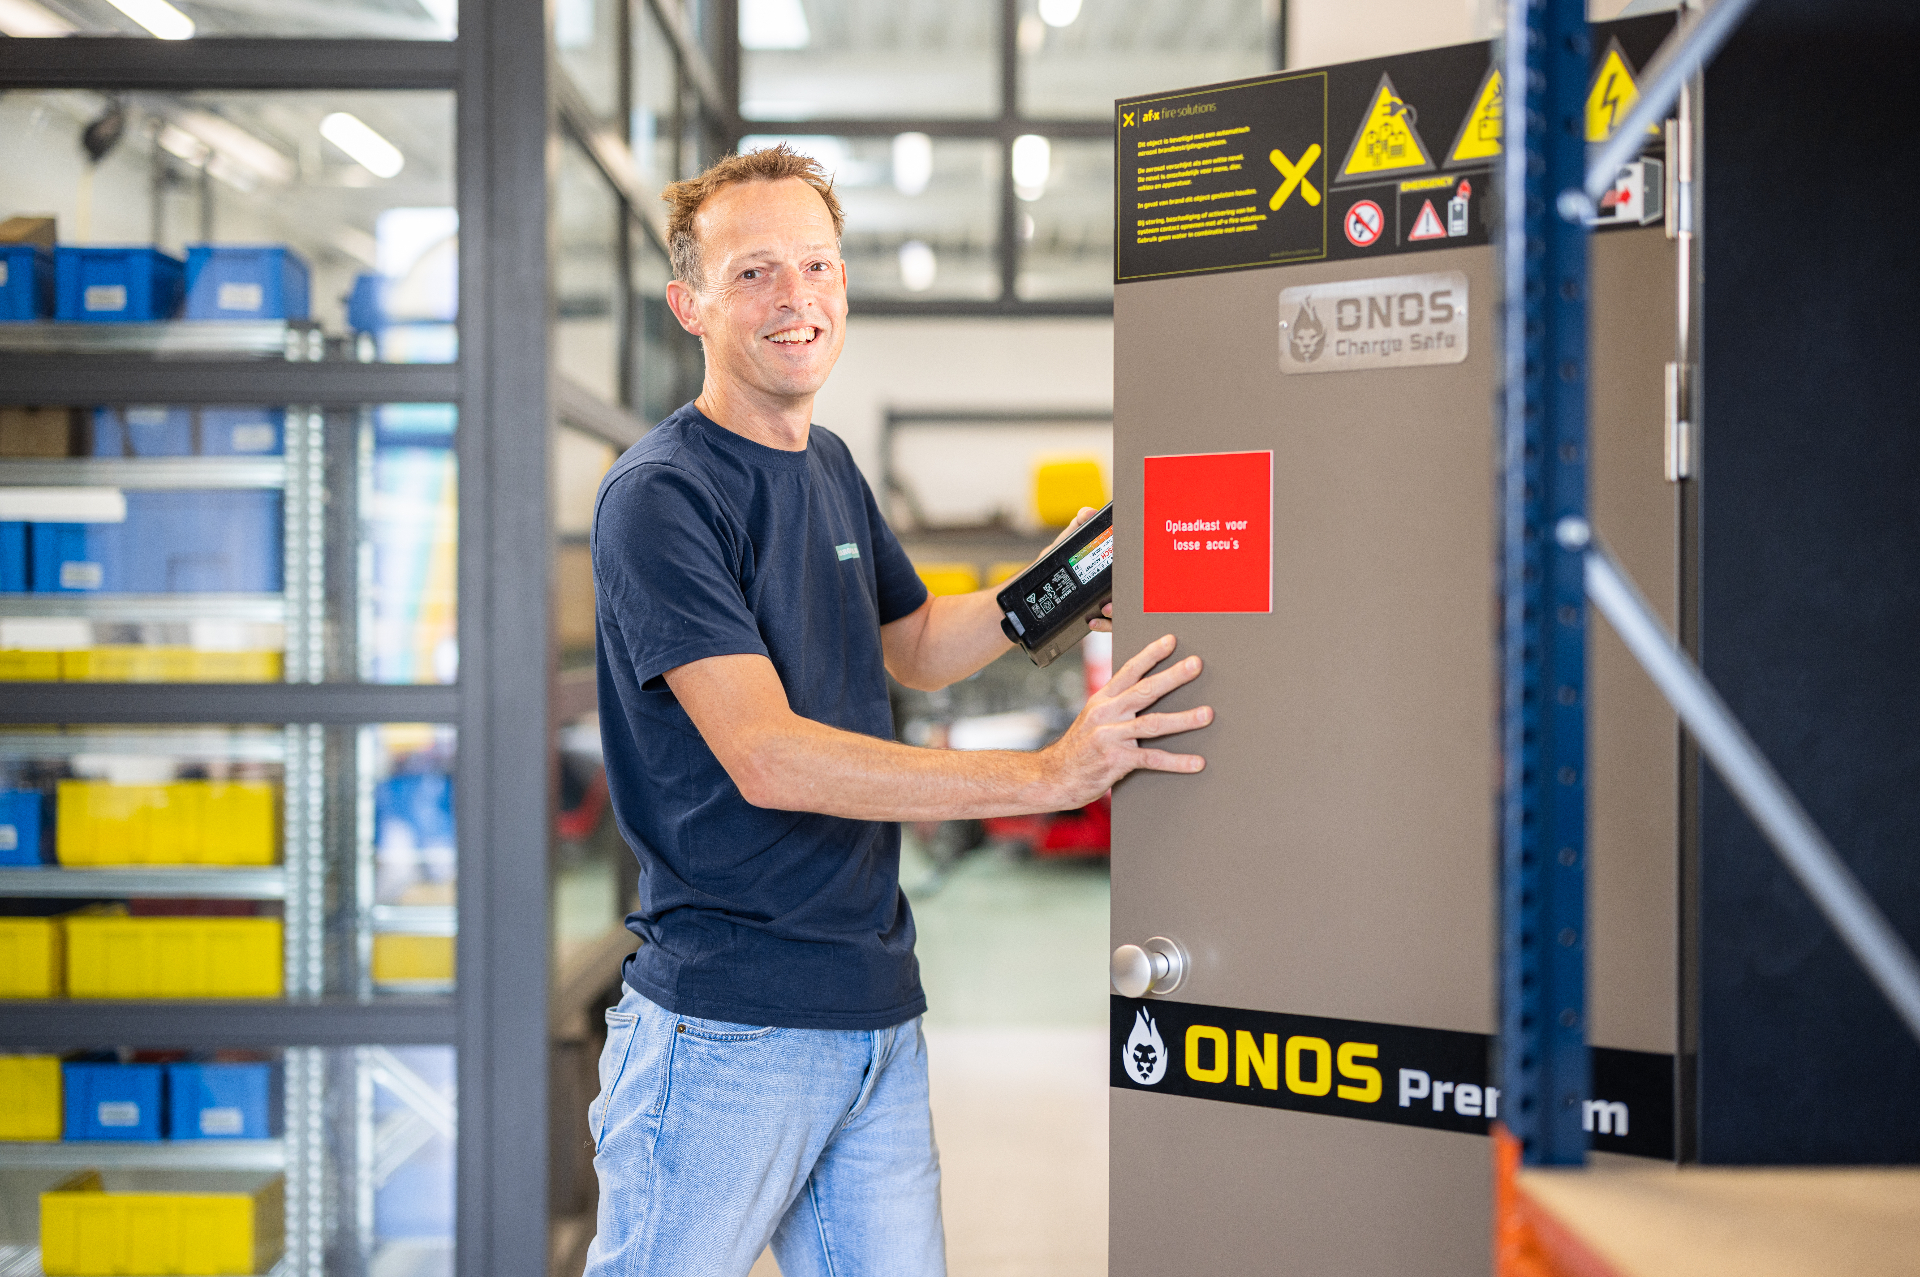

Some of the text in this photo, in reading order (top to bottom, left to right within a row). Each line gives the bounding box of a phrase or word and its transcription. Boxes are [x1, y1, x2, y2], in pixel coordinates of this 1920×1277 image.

[1161, 107, 1176, 119] fire
[1177, 104, 1216, 117] solutions
[1401, 176, 1454, 192] EMERGENCY
[1336, 290, 1453, 332] ONOS
[1336, 330, 1456, 357] Charge Safe
[1166, 519, 1248, 534] Oplaadkast voor
[1173, 537, 1239, 551] losse accu's
[1184, 1025, 1383, 1104] ONOS
[1398, 1067, 1630, 1136] Prem
